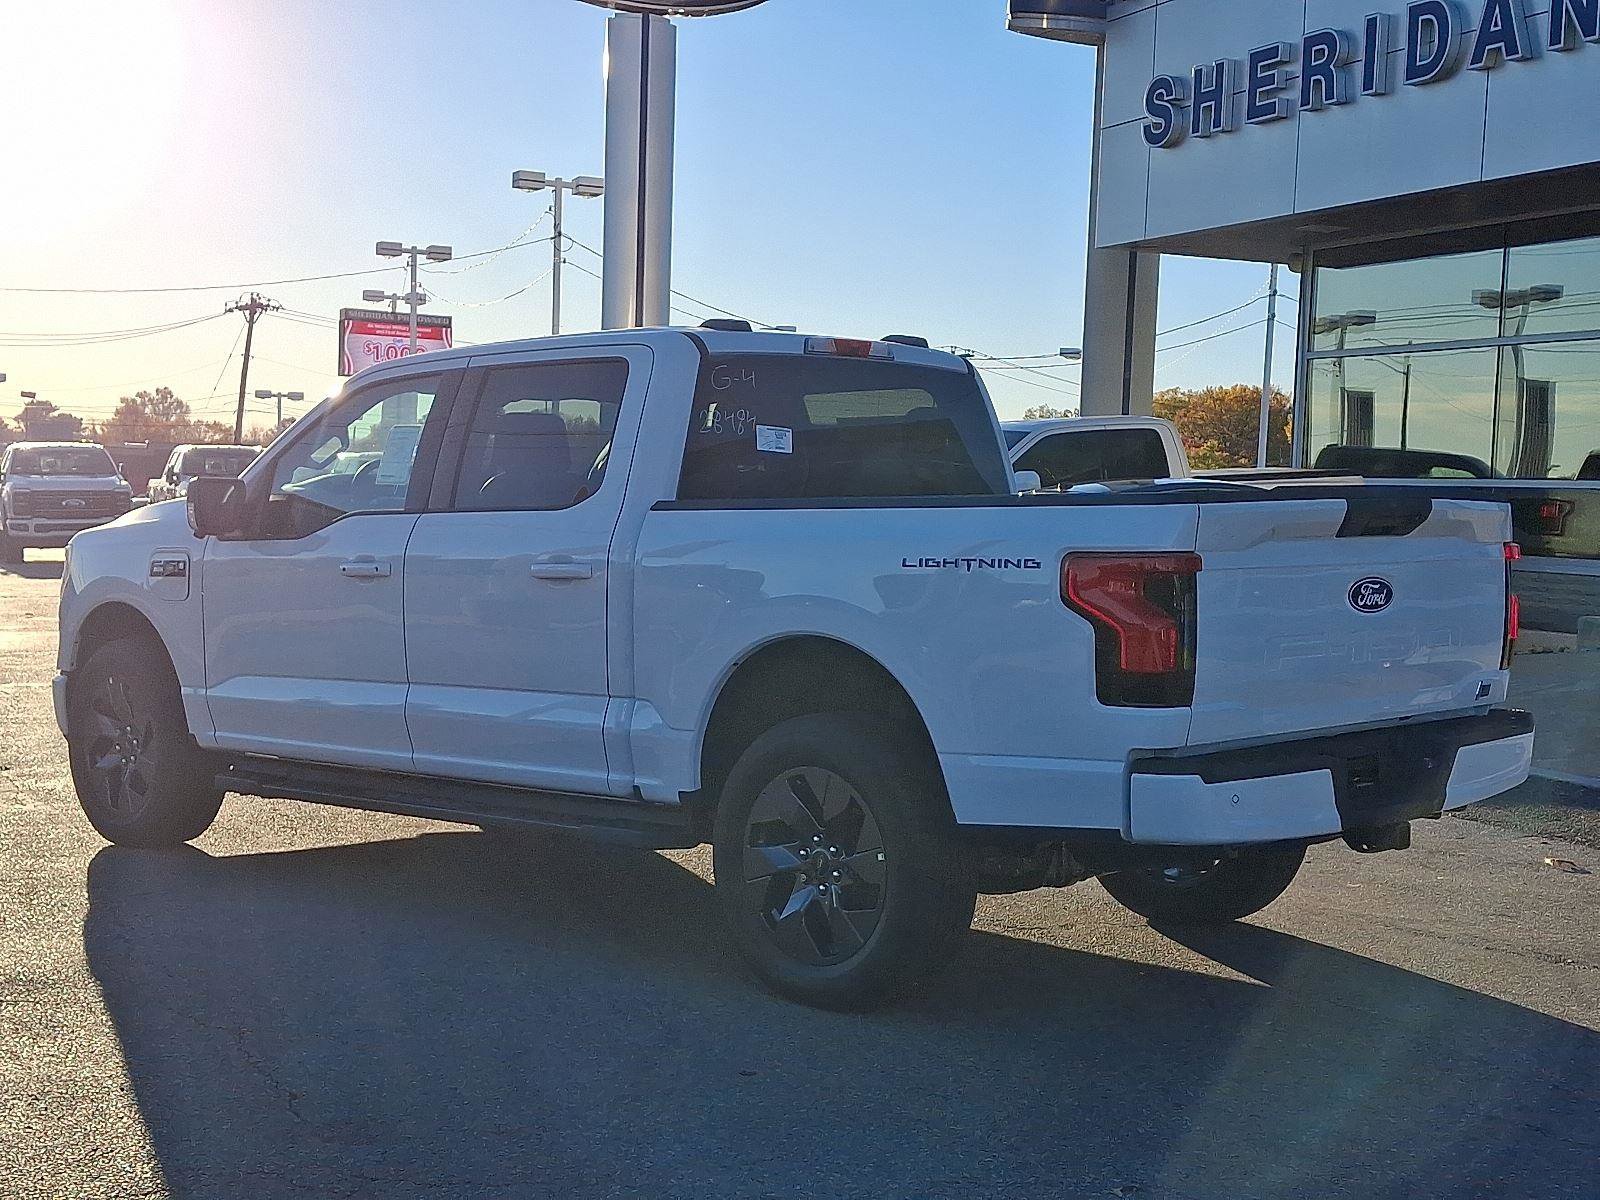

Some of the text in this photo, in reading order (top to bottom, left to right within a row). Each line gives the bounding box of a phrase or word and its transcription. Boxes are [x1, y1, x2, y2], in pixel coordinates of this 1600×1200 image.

[1142, 0, 1600, 148] SHERIDAN
[397, 314, 449, 325] PROWNED
[711, 364, 756, 390] G-4
[901, 557, 1042, 573] LIGHTNING
[1357, 583, 1387, 606] Ford
